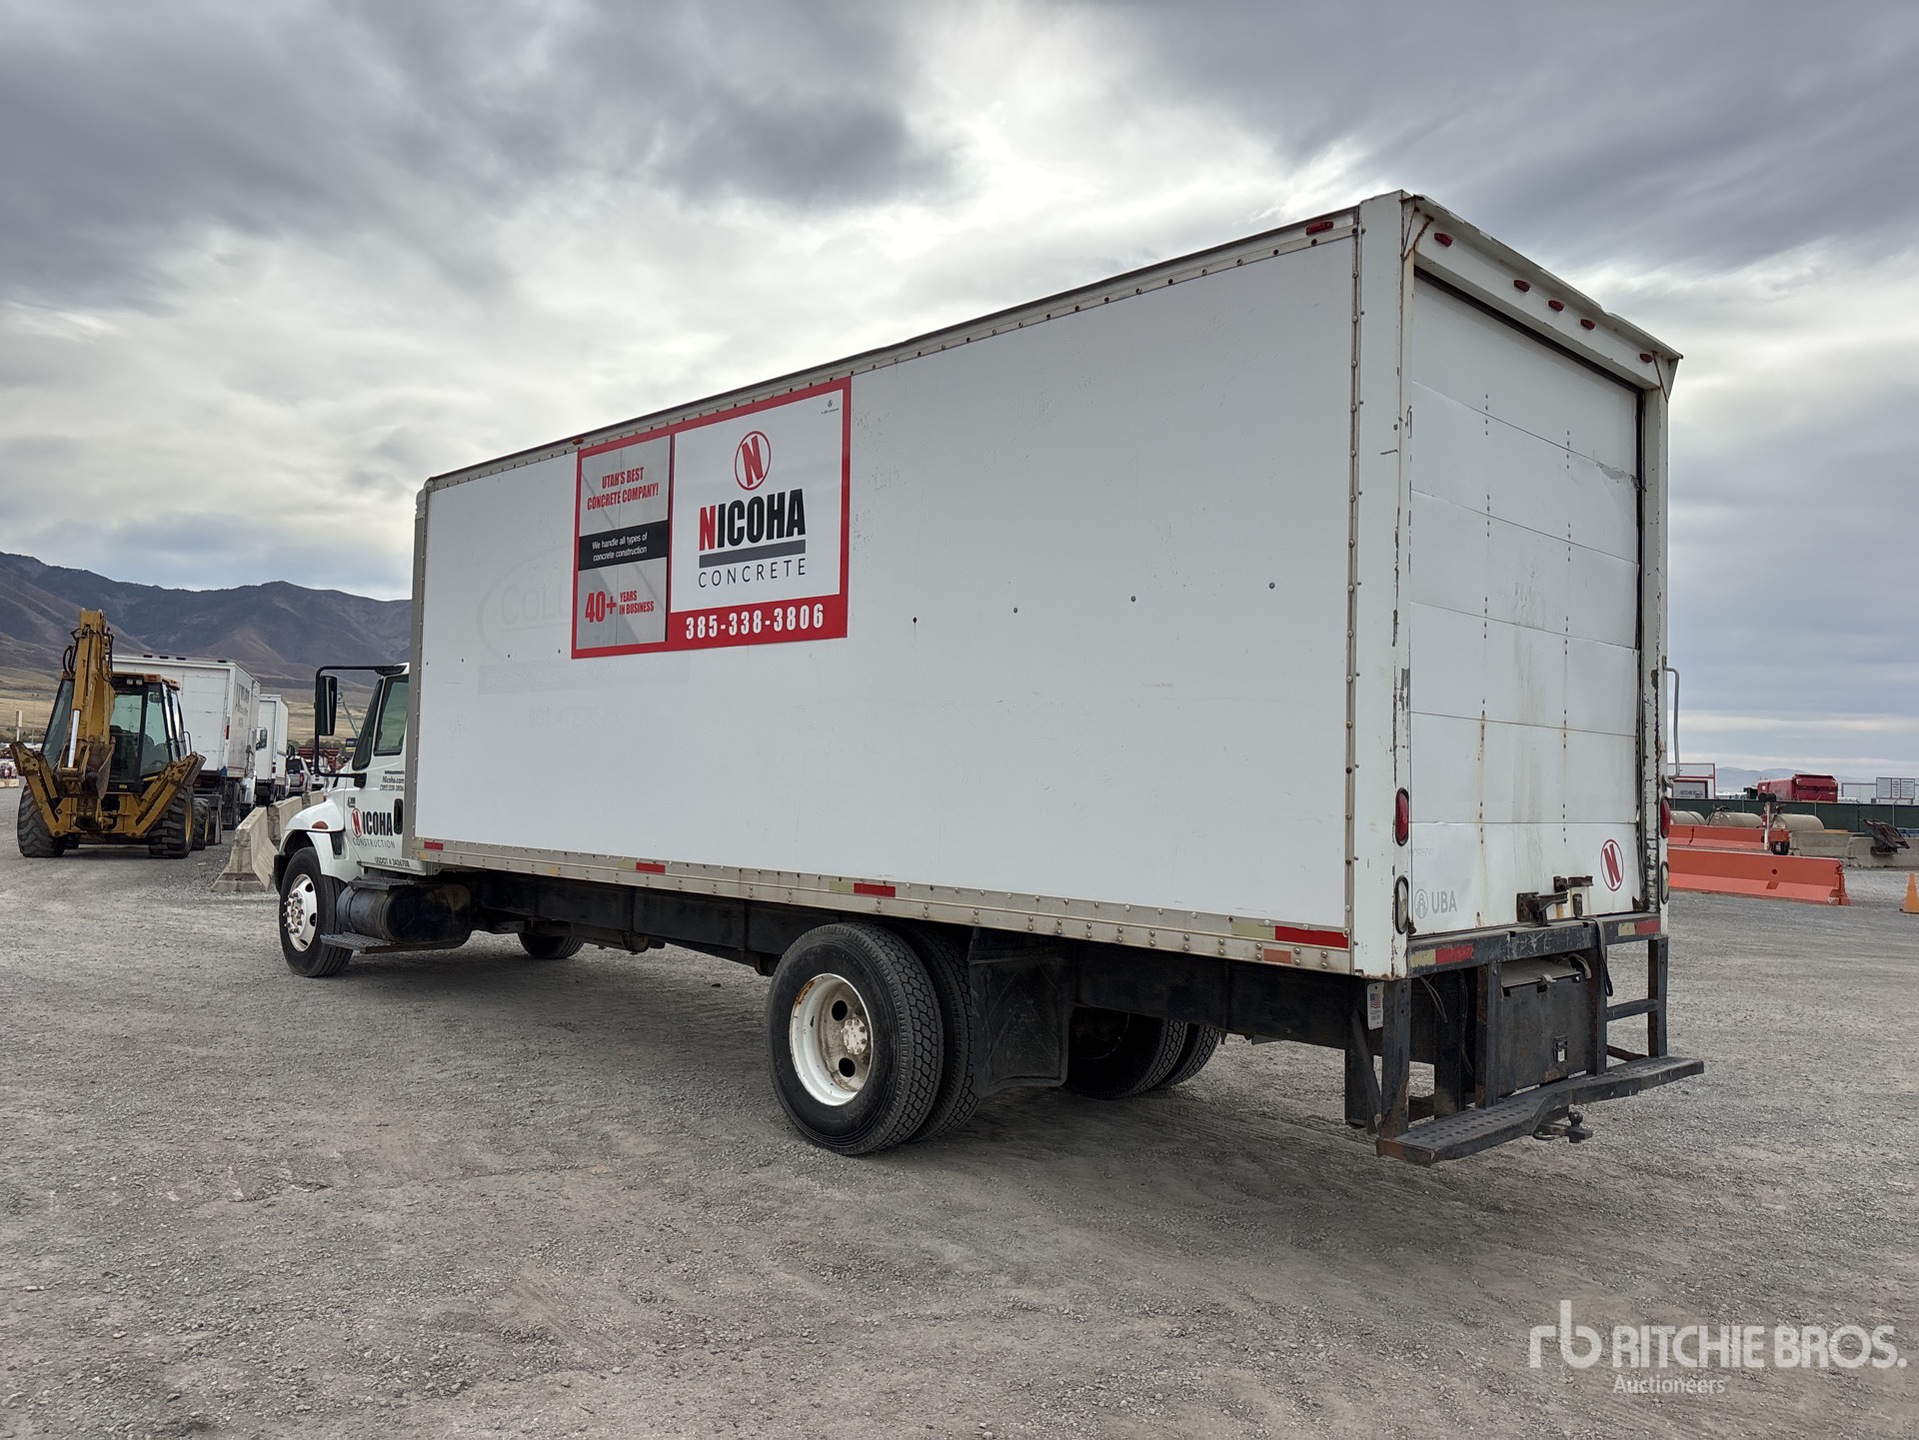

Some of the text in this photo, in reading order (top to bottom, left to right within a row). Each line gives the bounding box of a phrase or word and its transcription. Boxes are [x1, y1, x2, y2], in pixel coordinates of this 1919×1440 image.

[602, 466, 644, 489] UTAH'S BEST
[587, 482, 659, 511] CONCRETE COMPANY!
[699, 488, 806, 552] NICOHA
[592, 541, 600, 550] We
[601, 537, 618, 549] handle
[626, 534, 641, 546] types
[642, 532, 648, 541] of
[593, 546, 647, 562] concrete construction
[698, 558, 806, 588] CONCRETE
[585, 591, 617, 623] 40+
[619, 600, 654, 615] IN BUSINESS
[620, 590, 637, 602] YEARS
[685, 603, 824, 640] 385-338-3806
[352, 810, 393, 837] NICOHA
[352, 837, 395, 849] CONSTRUCTION
[1431, 890, 1457, 913] UBA
